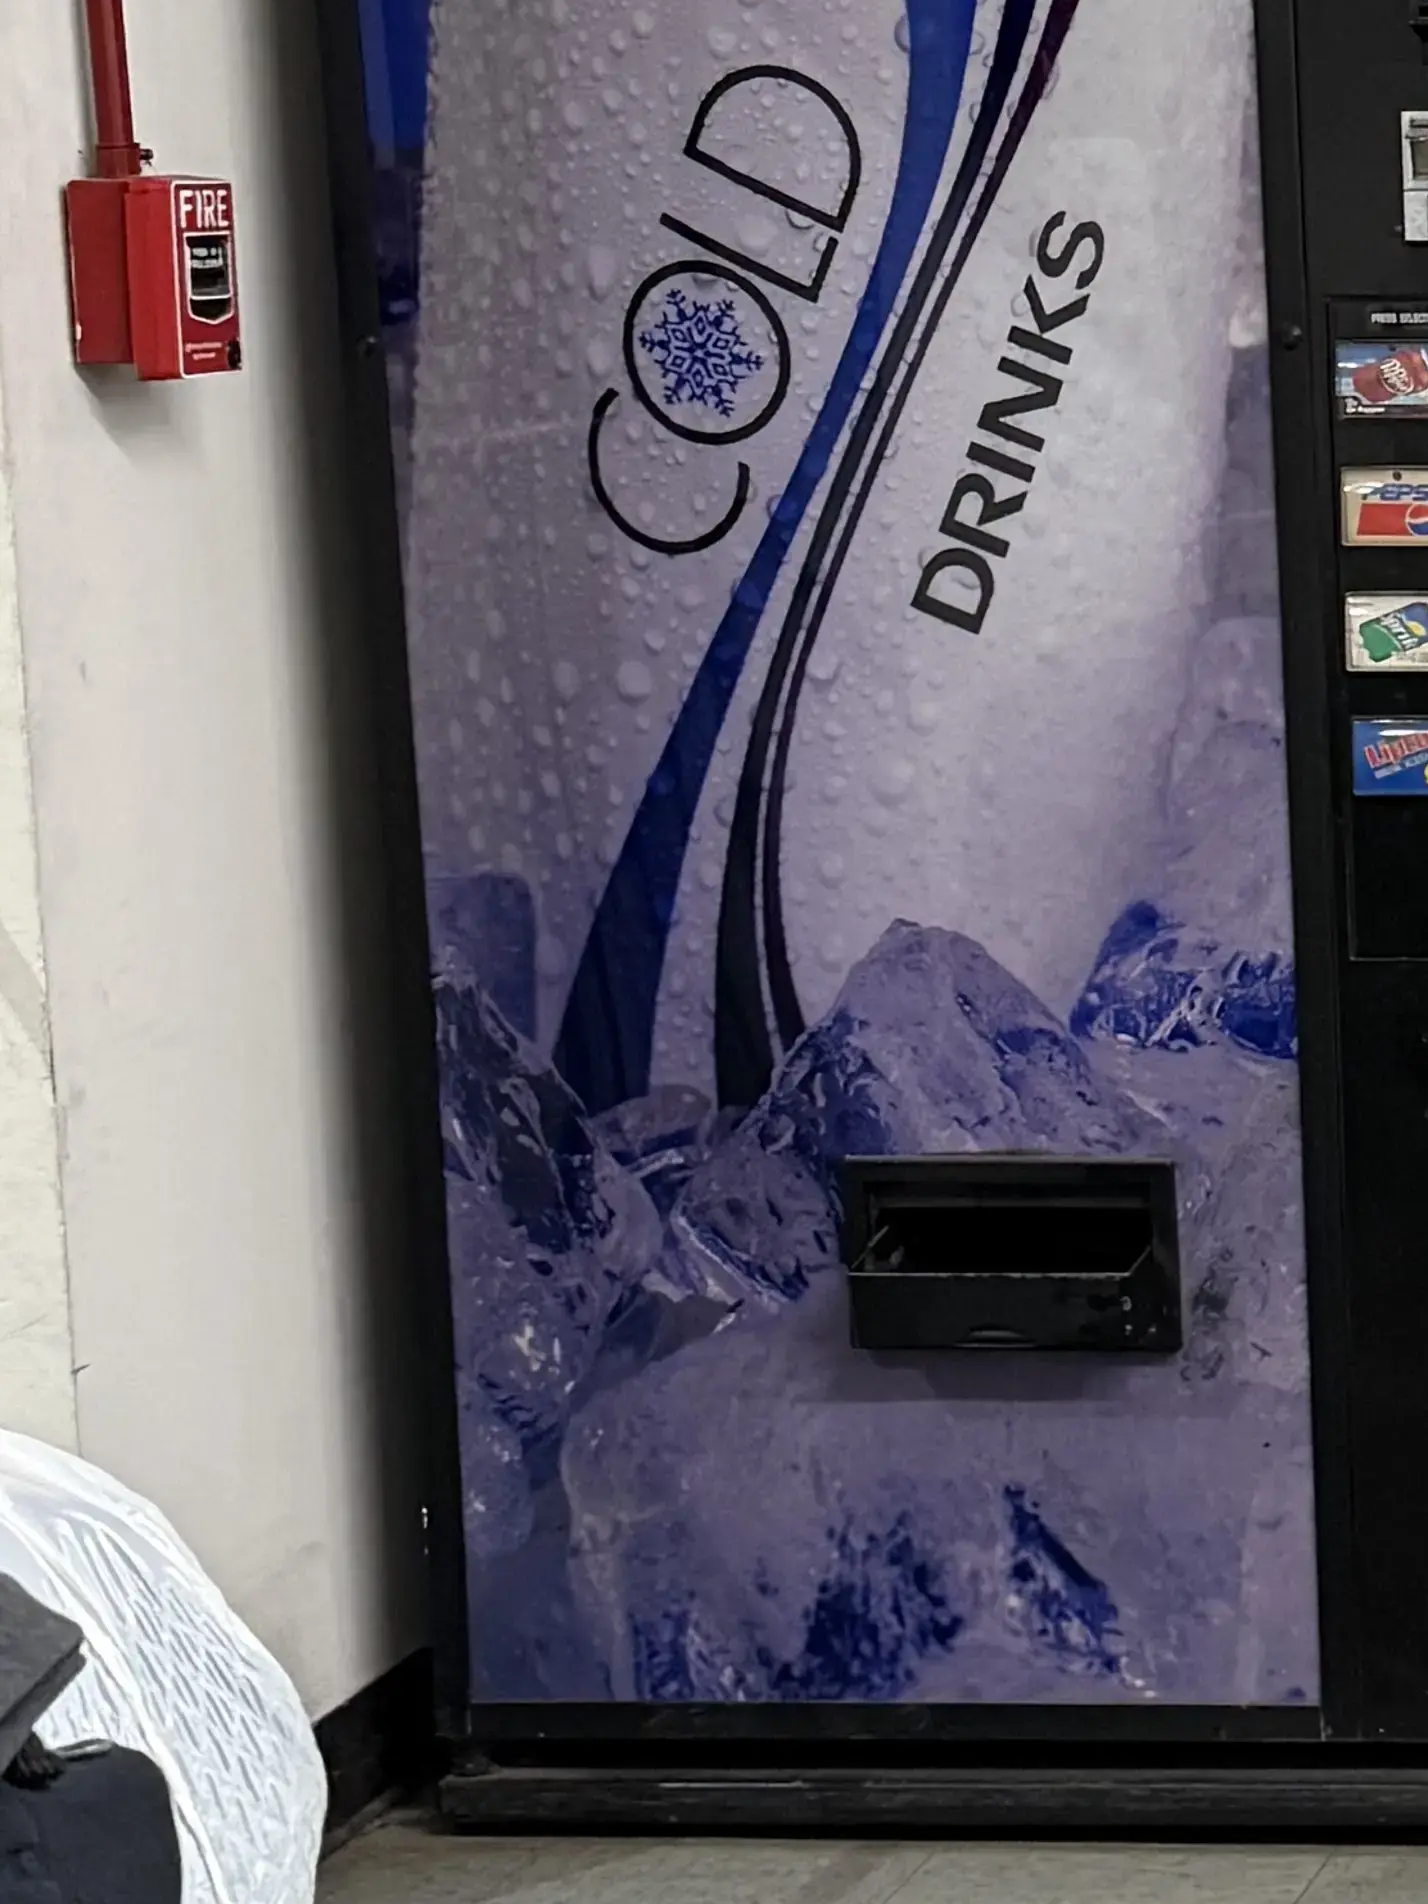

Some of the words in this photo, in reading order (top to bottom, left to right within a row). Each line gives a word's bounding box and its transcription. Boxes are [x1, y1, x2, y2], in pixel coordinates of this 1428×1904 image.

[178, 189, 230, 229] FIRE
[588, 64, 861, 555] COLD
[910, 210, 1105, 635] DRINKS
